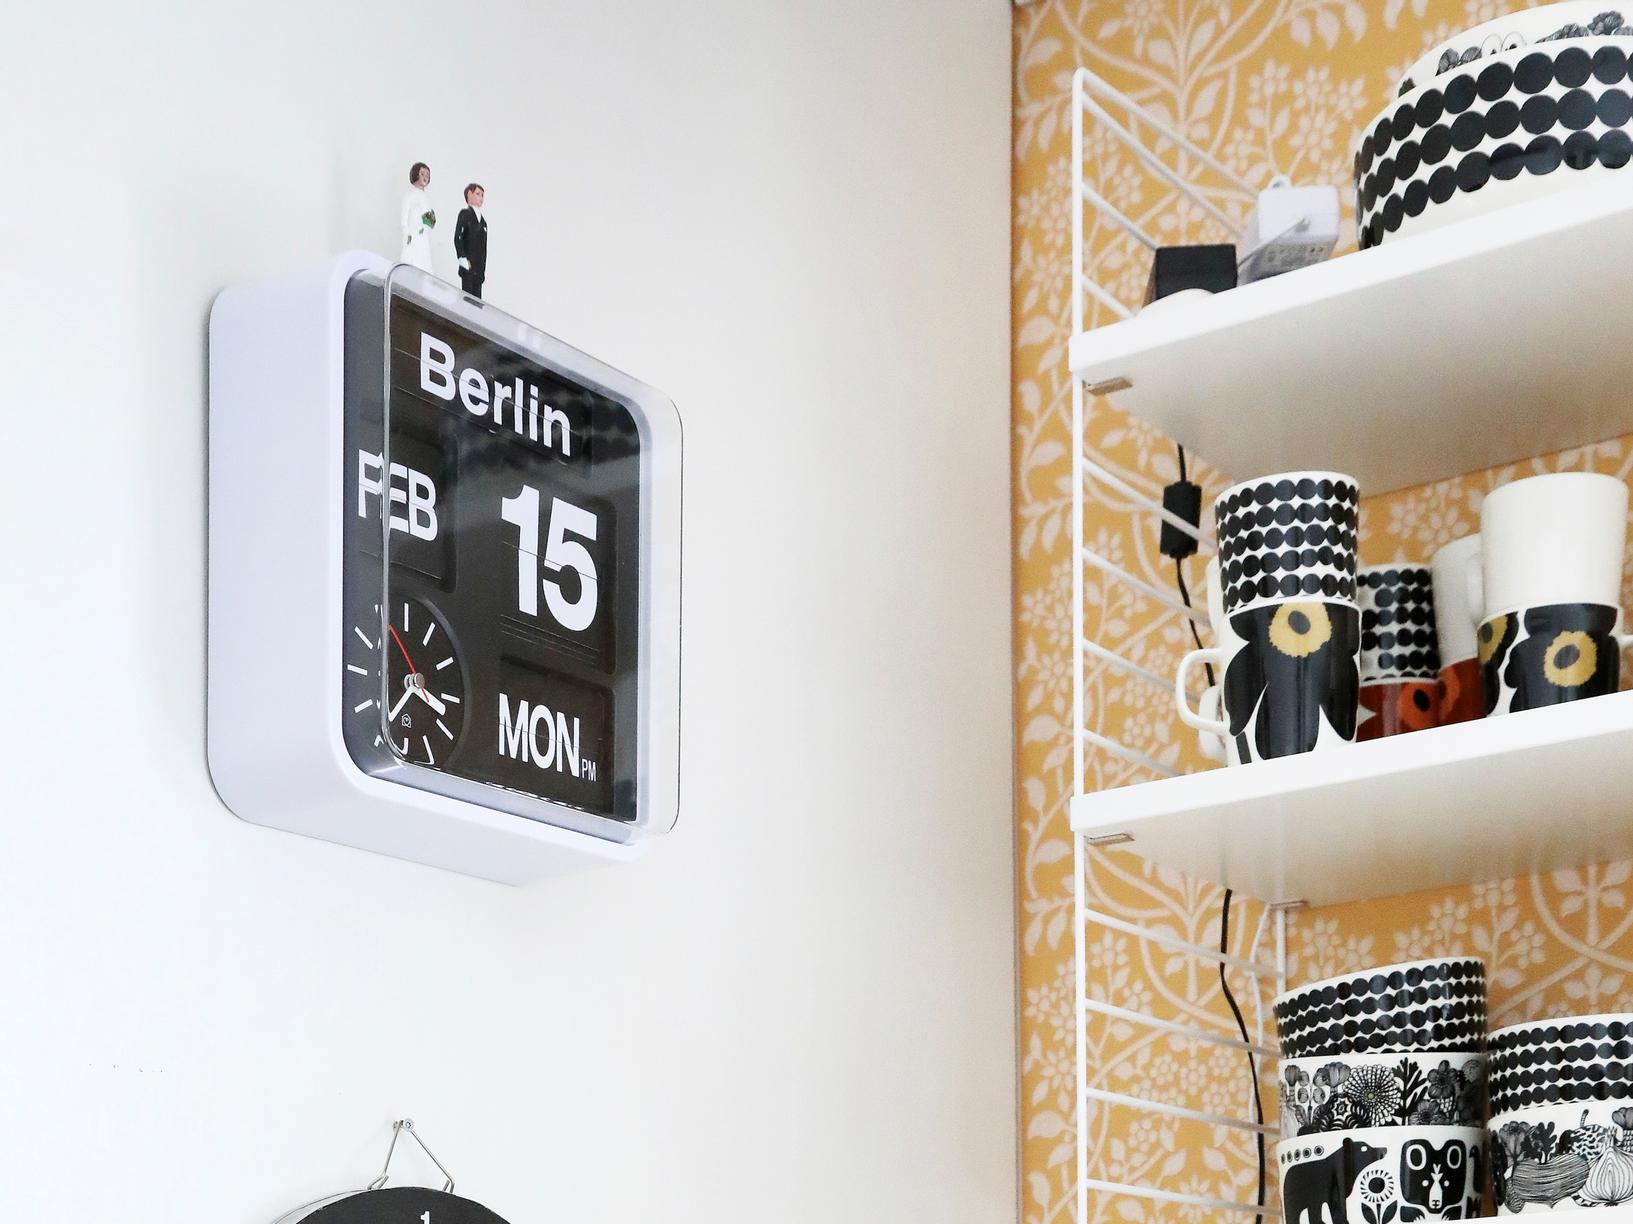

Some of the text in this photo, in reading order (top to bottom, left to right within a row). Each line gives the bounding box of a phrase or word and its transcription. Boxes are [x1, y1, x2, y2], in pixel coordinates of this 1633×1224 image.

[420, 331, 571, 457] Berlin
[359, 449, 438, 541] FEB
[501, 484, 598, 632] 15
[499, 692, 580, 778] MON
[582, 758, 597, 782] PM
